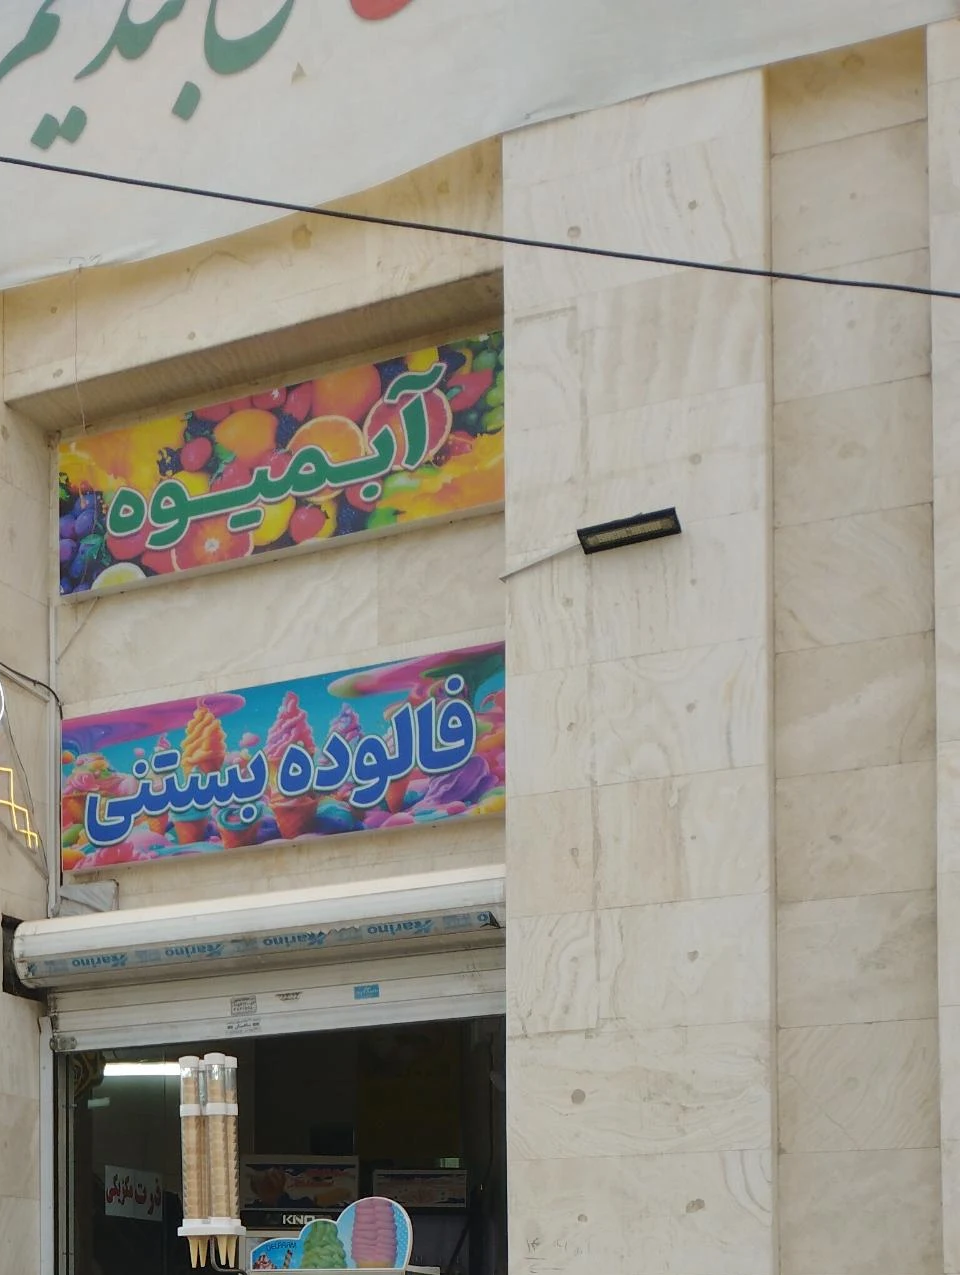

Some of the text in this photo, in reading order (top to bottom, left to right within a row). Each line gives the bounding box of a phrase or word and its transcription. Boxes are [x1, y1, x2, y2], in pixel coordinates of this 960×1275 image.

[107, 362, 446, 550] آبمیوه
[83, 673, 477, 847] فالوده بستنی
